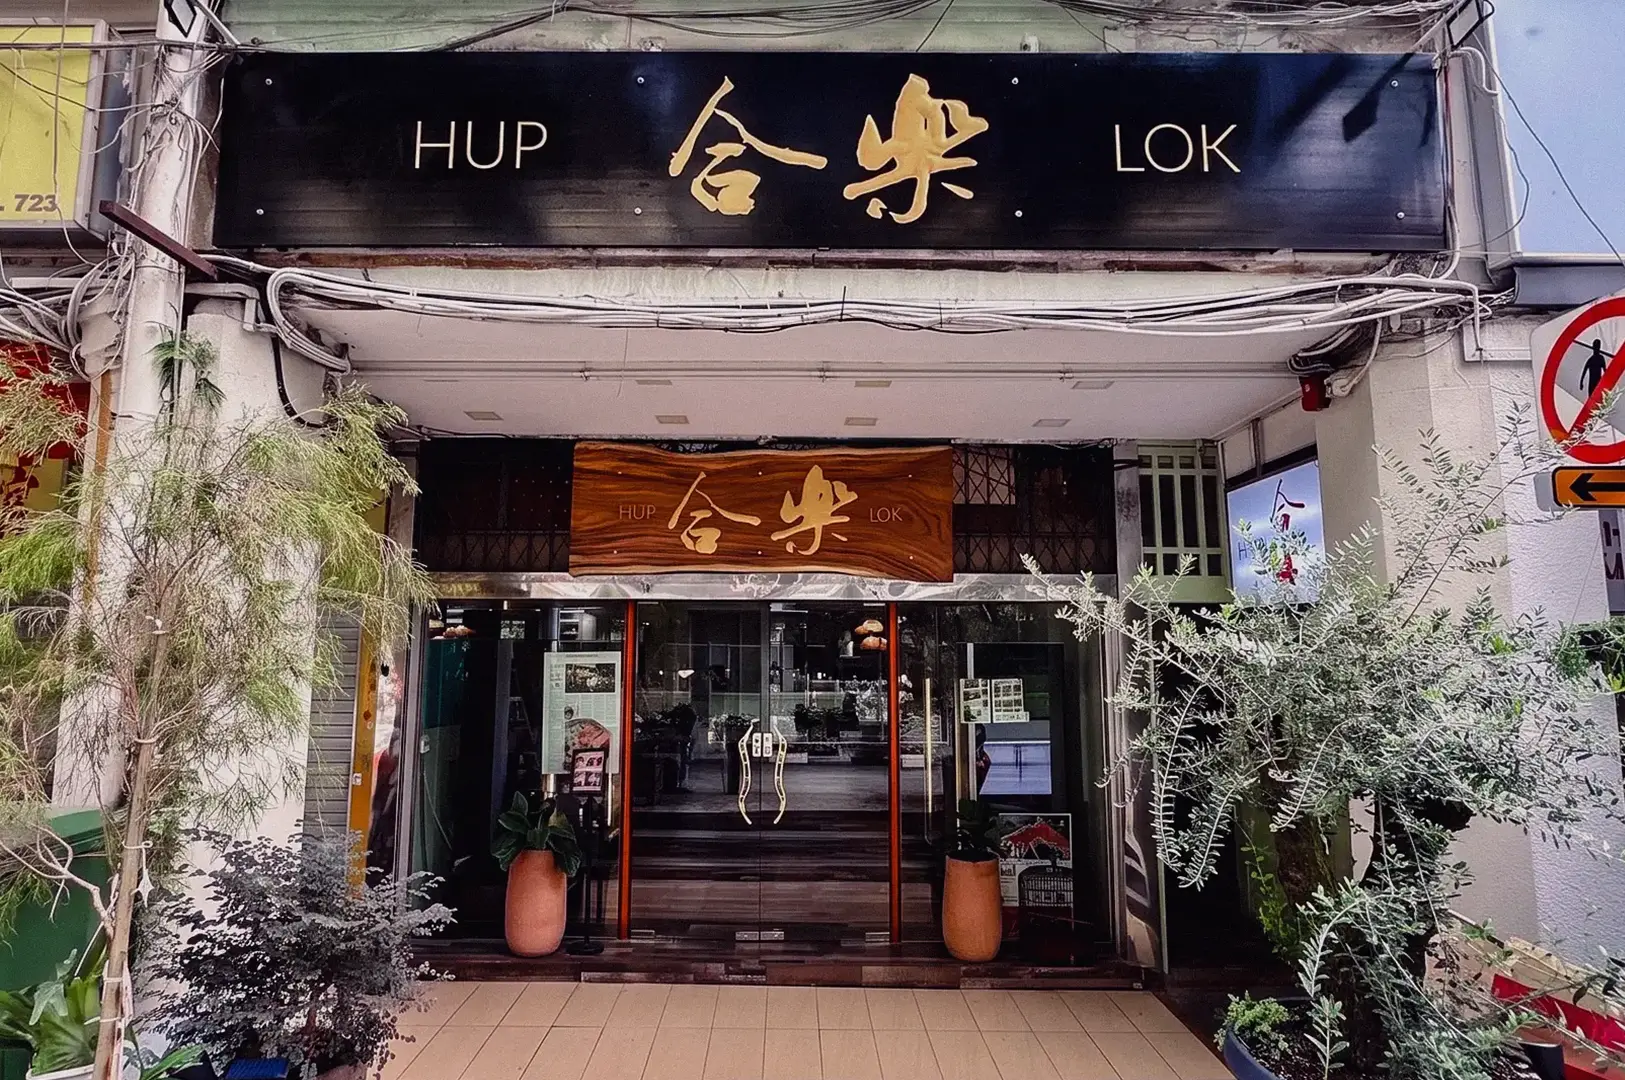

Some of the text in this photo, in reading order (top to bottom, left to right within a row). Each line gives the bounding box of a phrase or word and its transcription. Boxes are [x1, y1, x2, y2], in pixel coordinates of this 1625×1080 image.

[414, 121, 549, 170] HUP
[1114, 123, 1241, 174] LOK
[14, 194, 57, 212] 723
[618, 504, 656, 520] HUP
[869, 507, 904, 523] LOK
